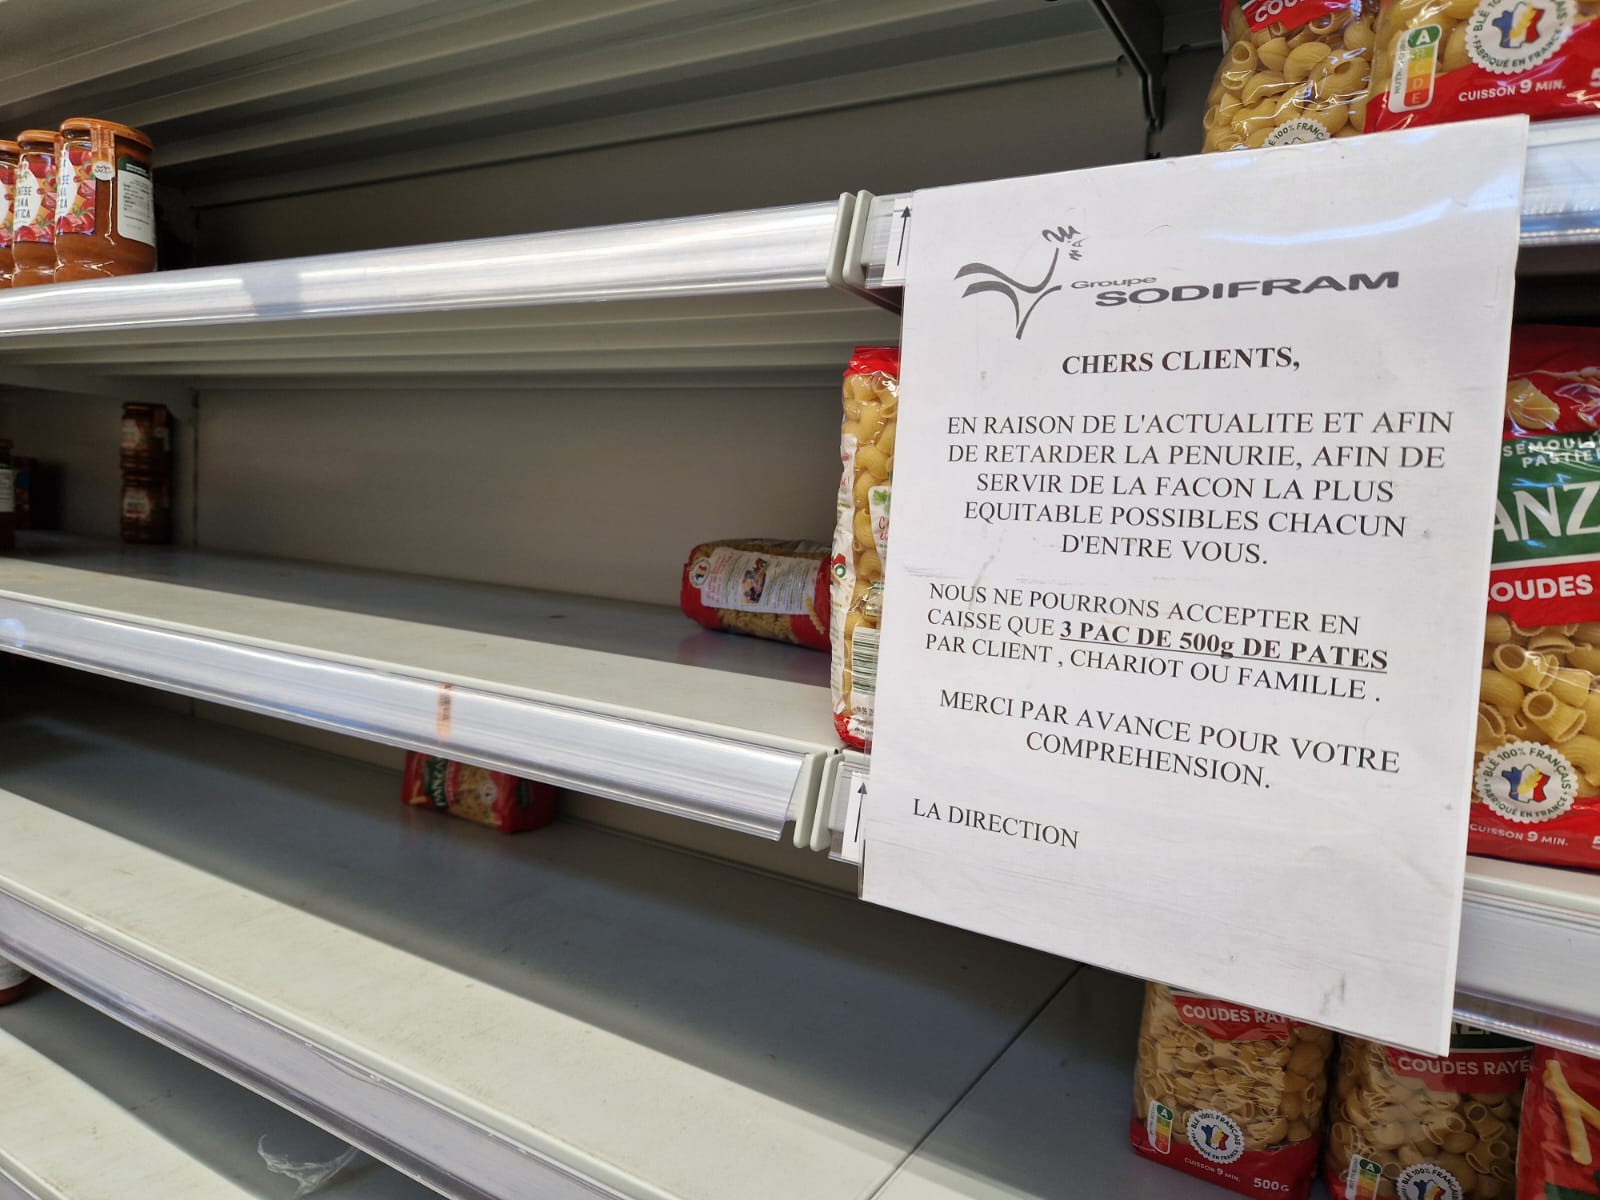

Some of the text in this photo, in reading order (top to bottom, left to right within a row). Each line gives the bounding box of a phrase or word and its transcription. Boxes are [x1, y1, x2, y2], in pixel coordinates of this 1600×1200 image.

[1416, 29, 1431, 46] A
[1458, 79, 1566, 102] CUISSON 9 MIN.
[1071, 277, 1156, 289] Groupe
[1095, 271, 1399, 306] SODIFRAM
[1062, 347, 1299, 374] CHERS CLIENTS,
[948, 412, 1454, 434] EN RAISON DE L'ACTUALITE ET AFIN
[949, 445, 1445, 470] DE RETARDER LA PENURIE, AFIN DE
[977, 473, 1393, 502] SERVIR DE LA FACON LA PLUS
[965, 501, 1407, 537] EQUITABLE POSSIBLES CHACUN
[1061, 535, 1268, 566] D'ENTRE VOUS.
[1487, 574, 1594, 602] OUDES
[930, 583, 1359, 636] NOUS NE POURRONS ACCEPTER EN
[928, 609, 1389, 669] CAISSE QUE 3 PAC DE 500g DE PATES
[926, 634, 966, 653] PAR
[972, 639, 1052, 662] CLIENT
[1071, 649, 1183, 678] CHARIOT
[1191, 662, 1229, 683] OU
[1237, 667, 1366, 699] FAMILLE
[940, 689, 1399, 773] MERCI PAR AVANCE POUR VOTRE
[1026, 731, 1271, 789] COMPREHENSION.
[1483, 747, 1572, 790] BLÉ 100% FRANÇAIS
[1483, 783, 1518, 817] FABRIQUÉ
[1535, 795, 1568, 817] FRANCE
[914, 798, 1078, 849] LA DIRECTION
[1469, 823, 1569, 846] CUISSON 9 MIN.
[1182, 1005, 1250, 1023] COUDES
[1398, 1055, 1533, 1075] COUDES RAYÉ
[1184, 1157, 1215, 1173] CUISSON
